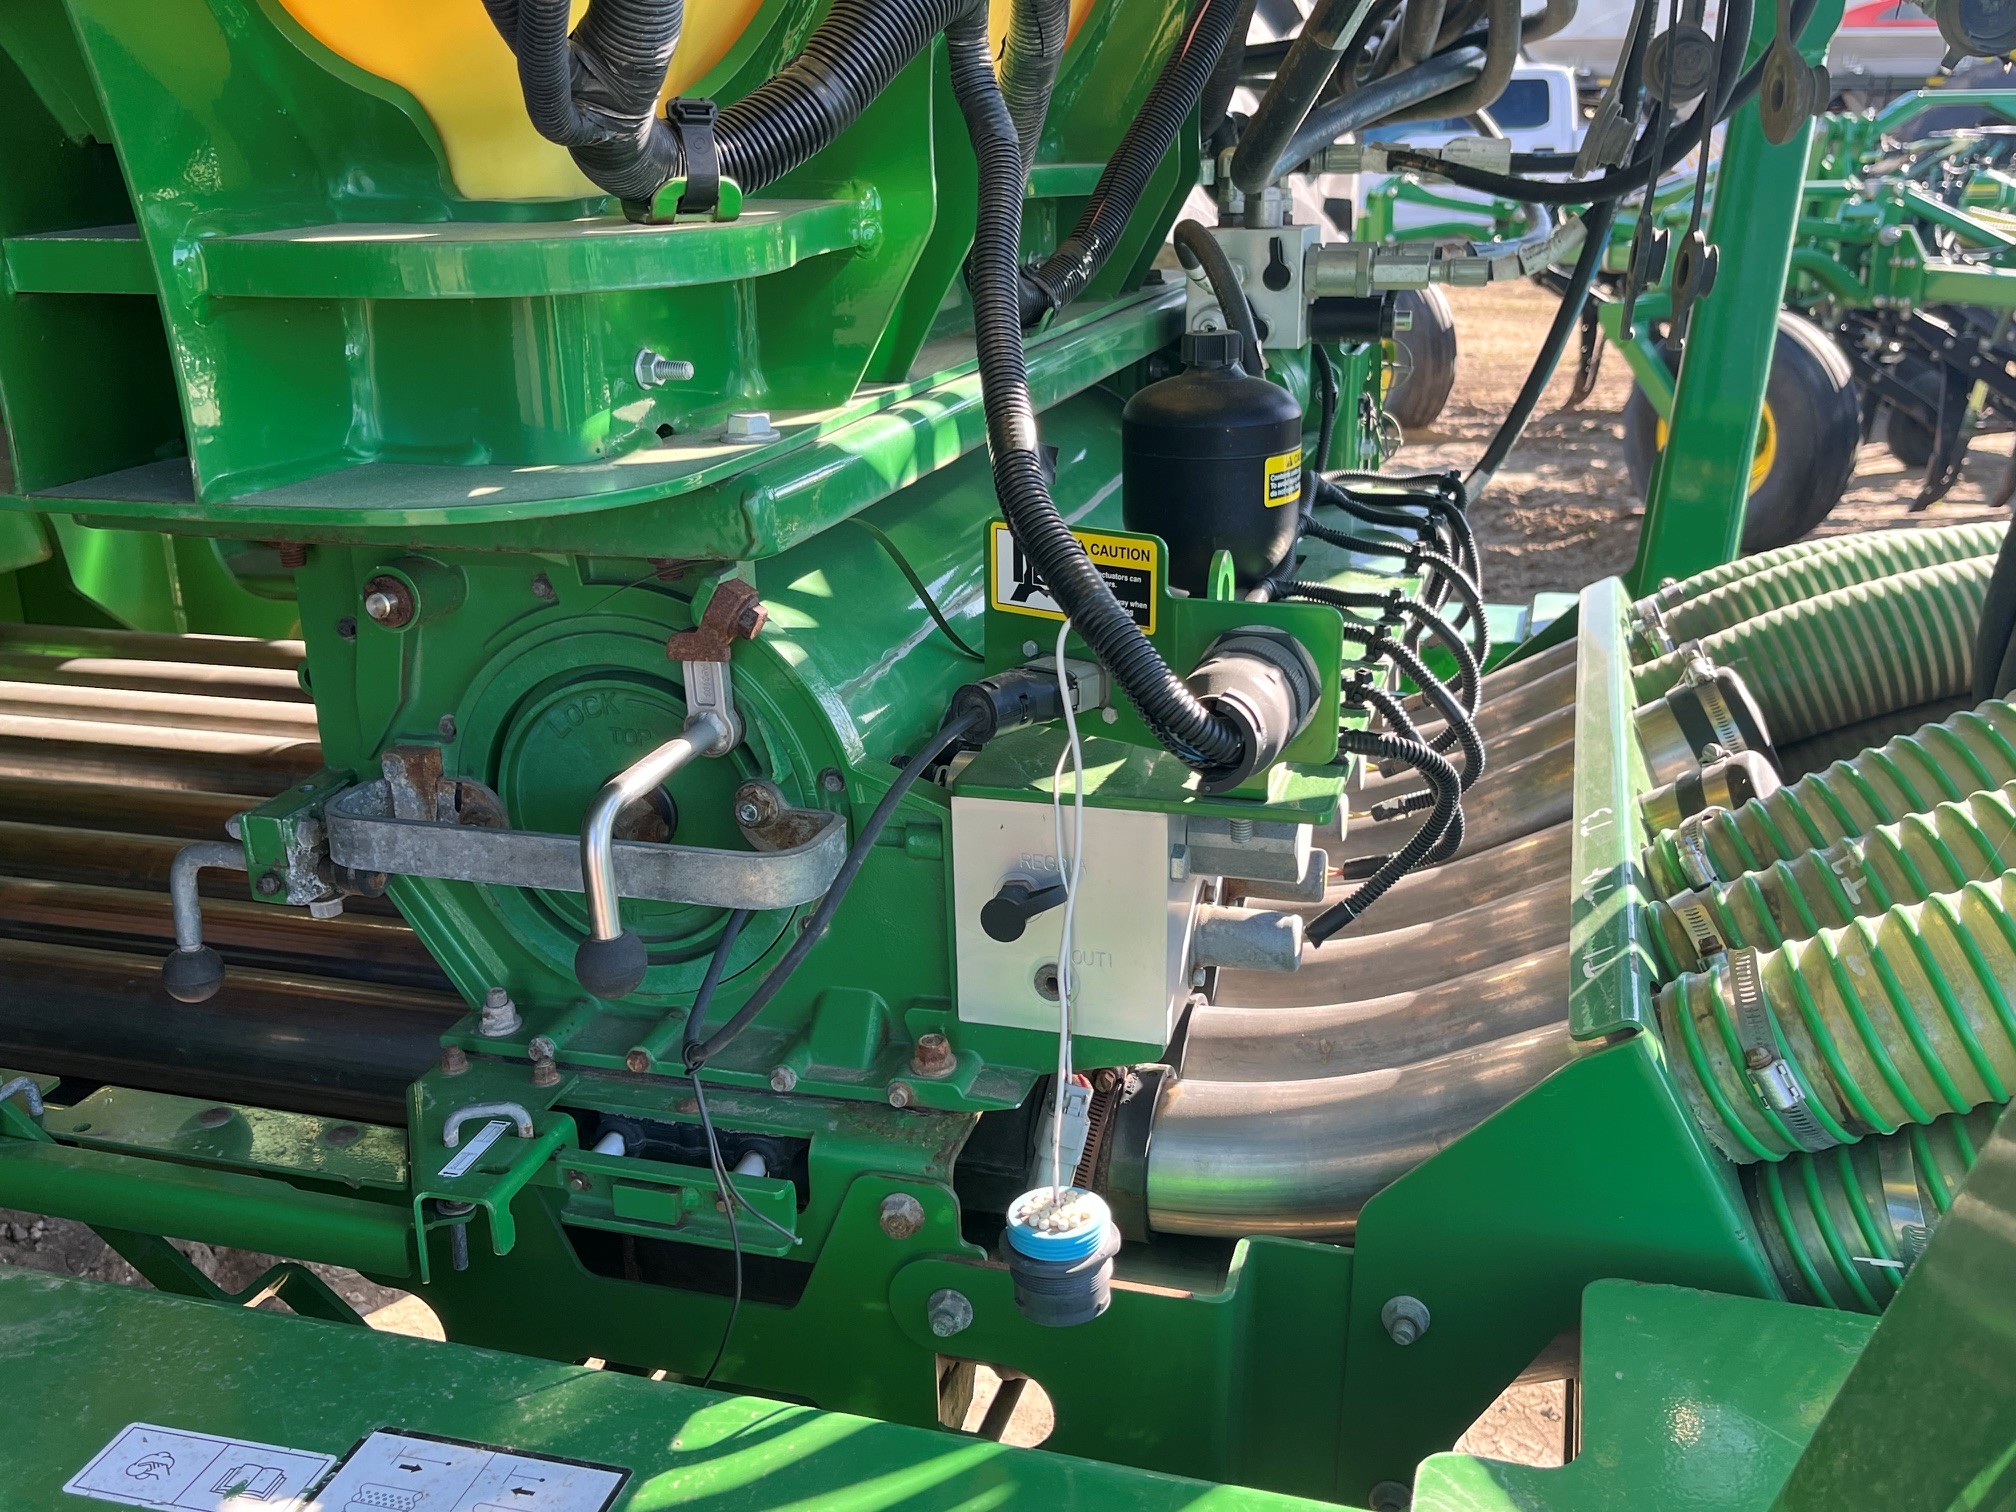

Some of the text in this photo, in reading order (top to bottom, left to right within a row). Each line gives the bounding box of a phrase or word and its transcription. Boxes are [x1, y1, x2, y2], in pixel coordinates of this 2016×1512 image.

[1090, 543, 1150, 562] CAUTION
[1129, 575, 1142, 584] can
[1129, 600, 1148, 610] when
[546, 691, 620, 739] LOCK
[607, 726, 652, 747] TOP
[1071, 949, 1113, 969] OUT1
